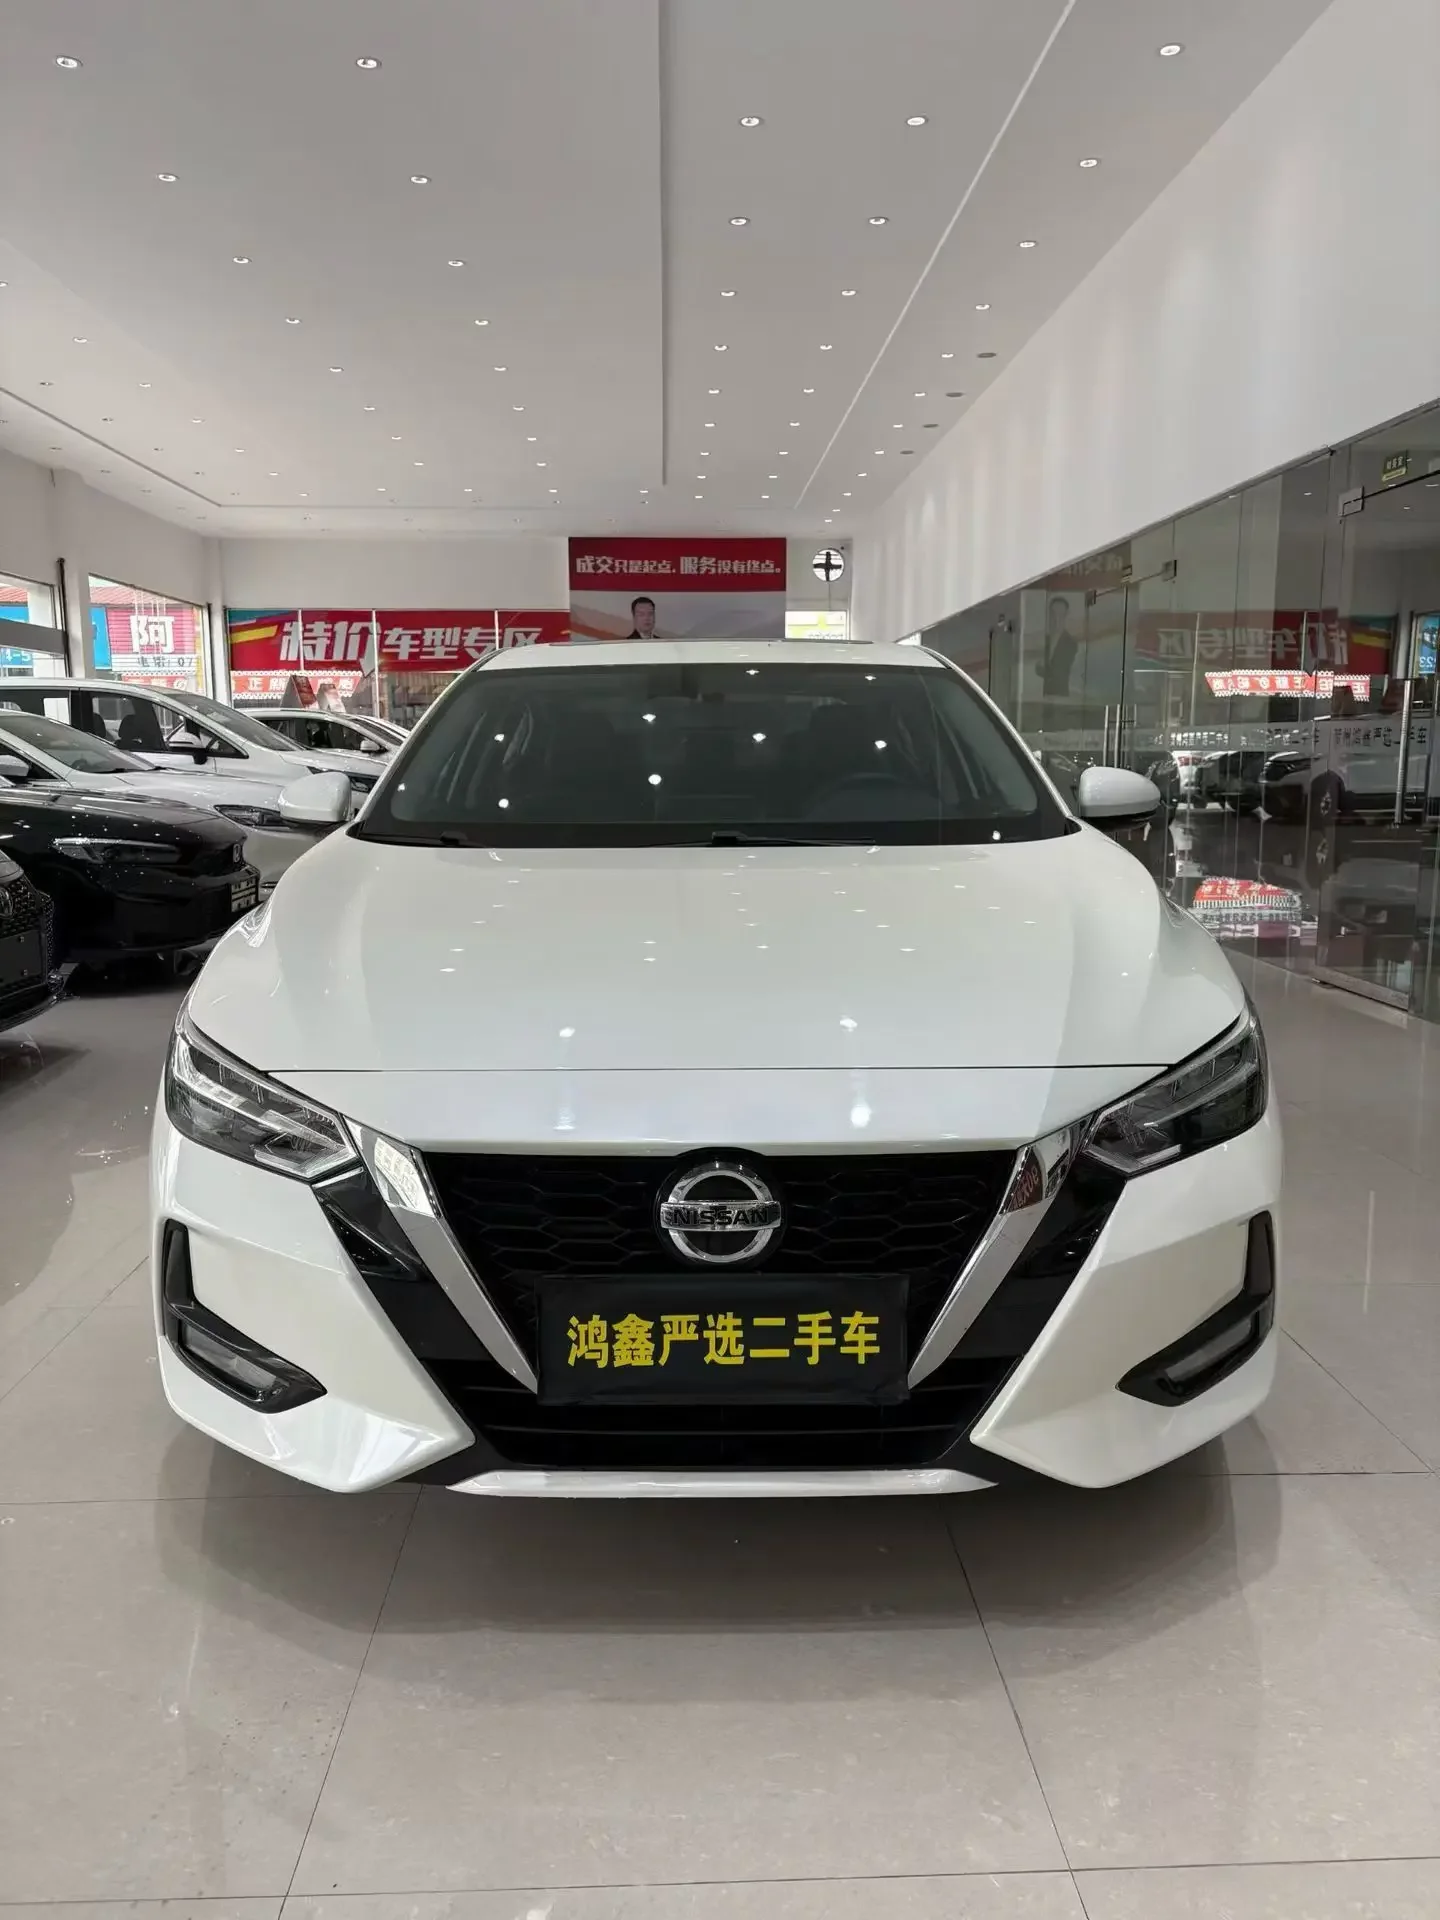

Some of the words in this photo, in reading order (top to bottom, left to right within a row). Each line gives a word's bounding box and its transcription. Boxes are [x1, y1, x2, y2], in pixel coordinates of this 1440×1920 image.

[129, 615, 175, 653] 阿
[673, 1208, 769, 1226] NISSAN
[567, 1311, 880, 1368] 鸿鑫严选二手车
